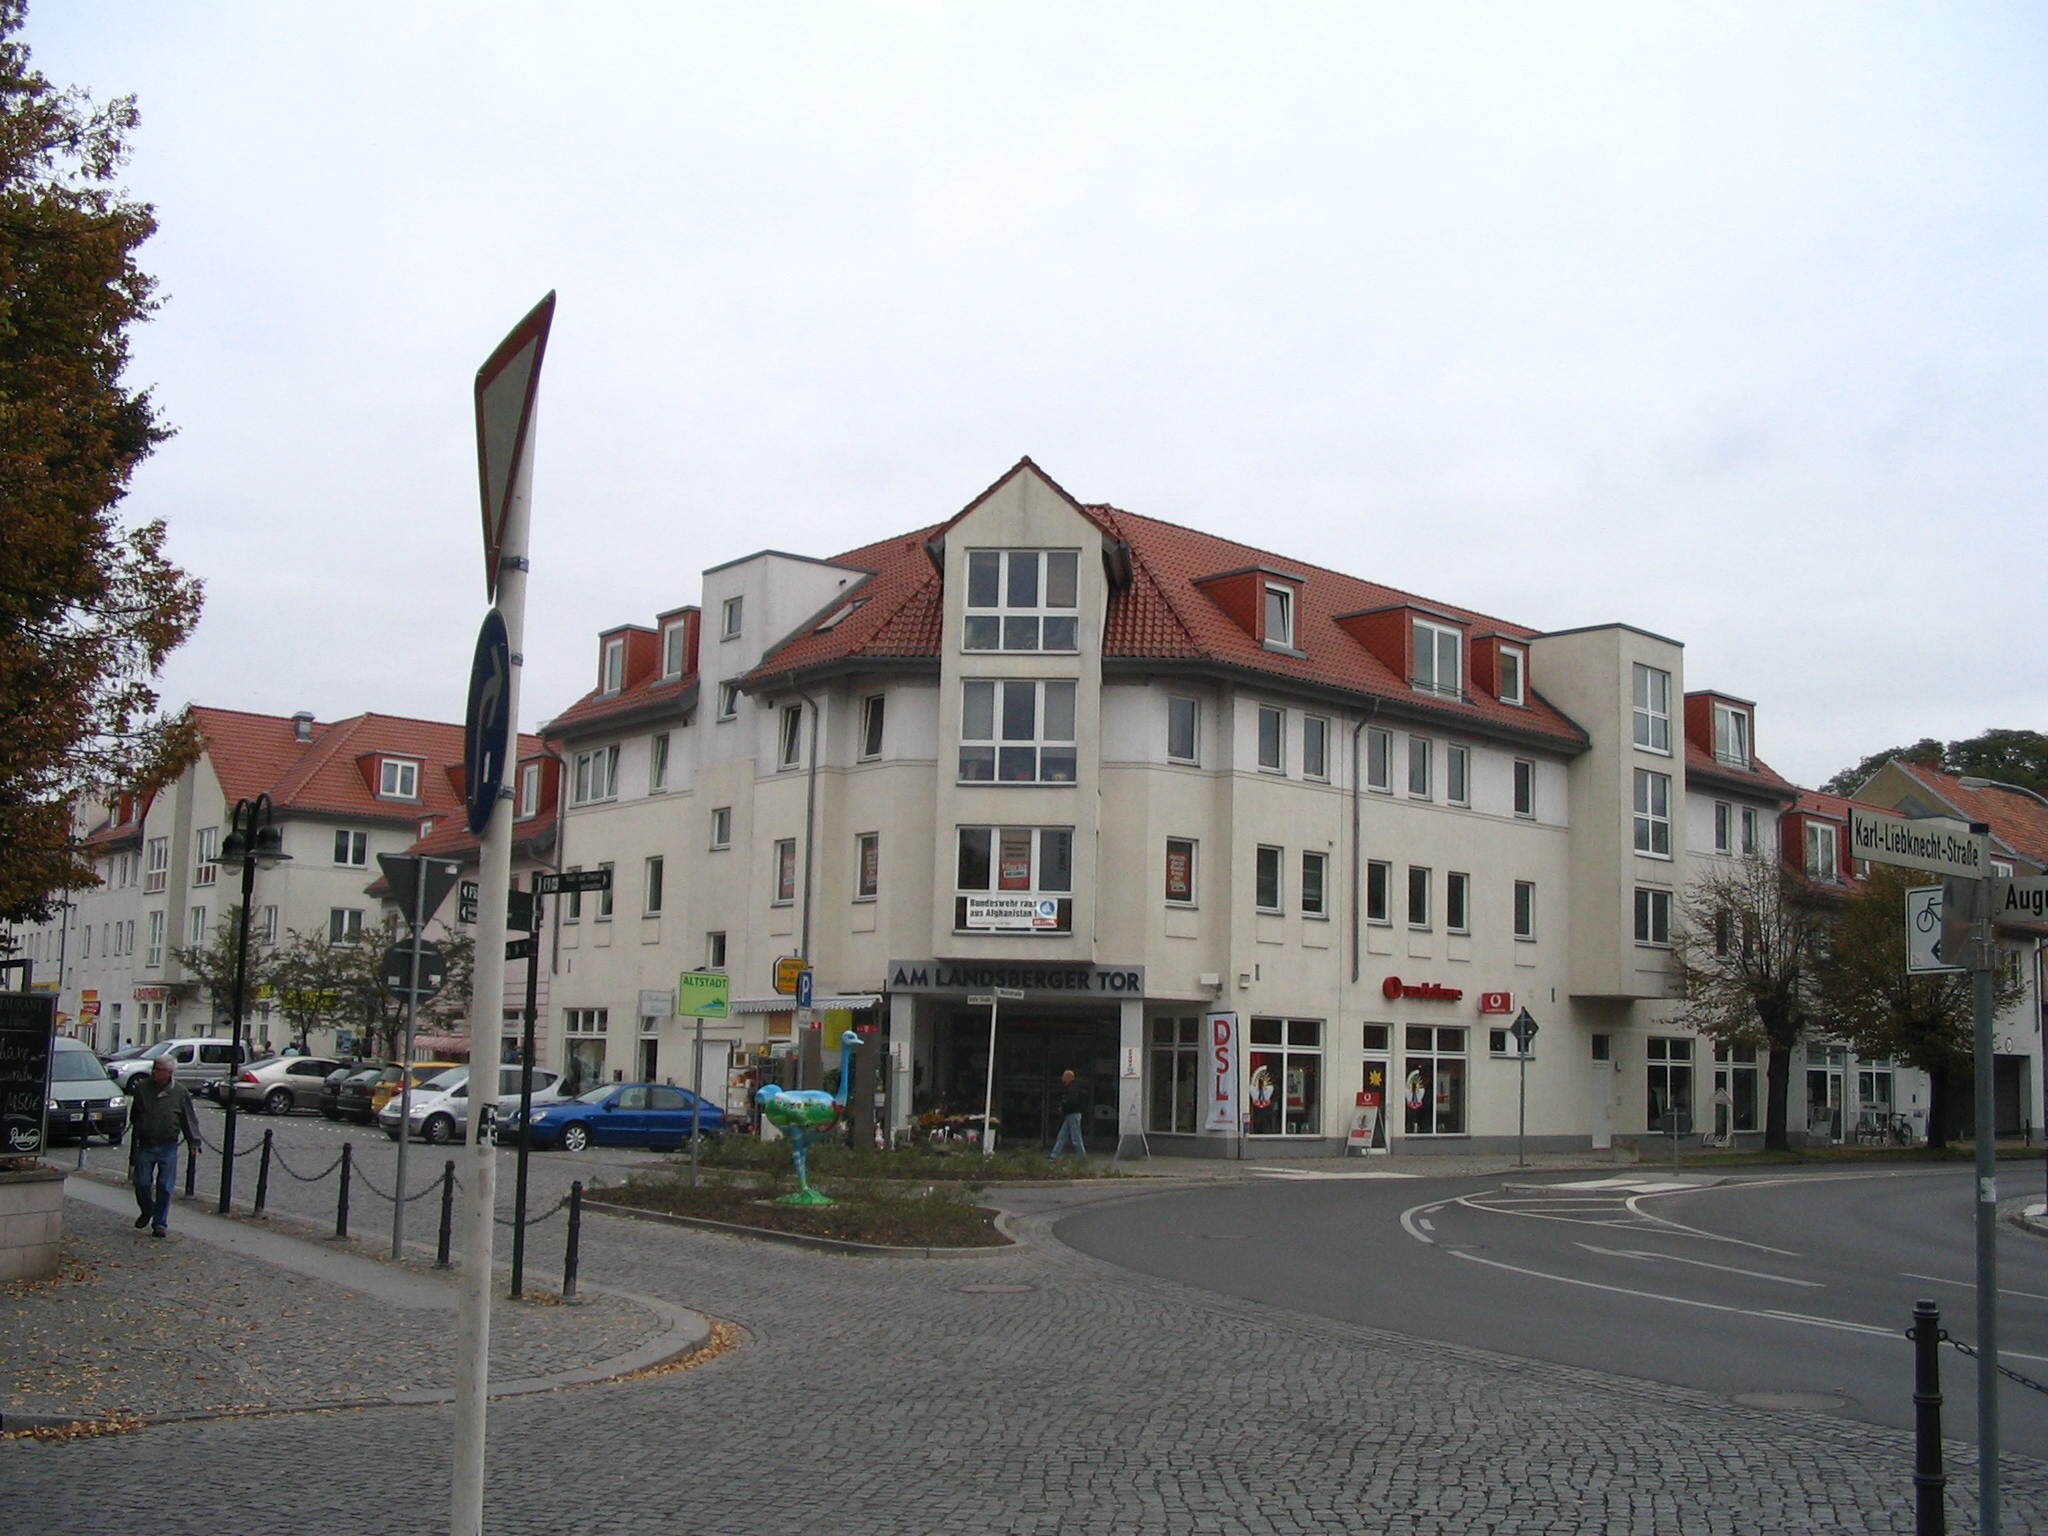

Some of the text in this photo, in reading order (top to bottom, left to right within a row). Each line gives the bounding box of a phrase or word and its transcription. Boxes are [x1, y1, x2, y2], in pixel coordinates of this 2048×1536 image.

[1855, 816, 1979, 868] Karl-Liebknecht-Straße
[970, 909, 983, 917] aus
[985, 908, 1032, 918] Afghanistan
[683, 976, 727, 989] ALTSTADT
[802, 976, 809, 1003] P
[893, 968, 1140, 992] AM LANDSBERGER TOR
[1213, 1019, 1231, 1101] DSL
